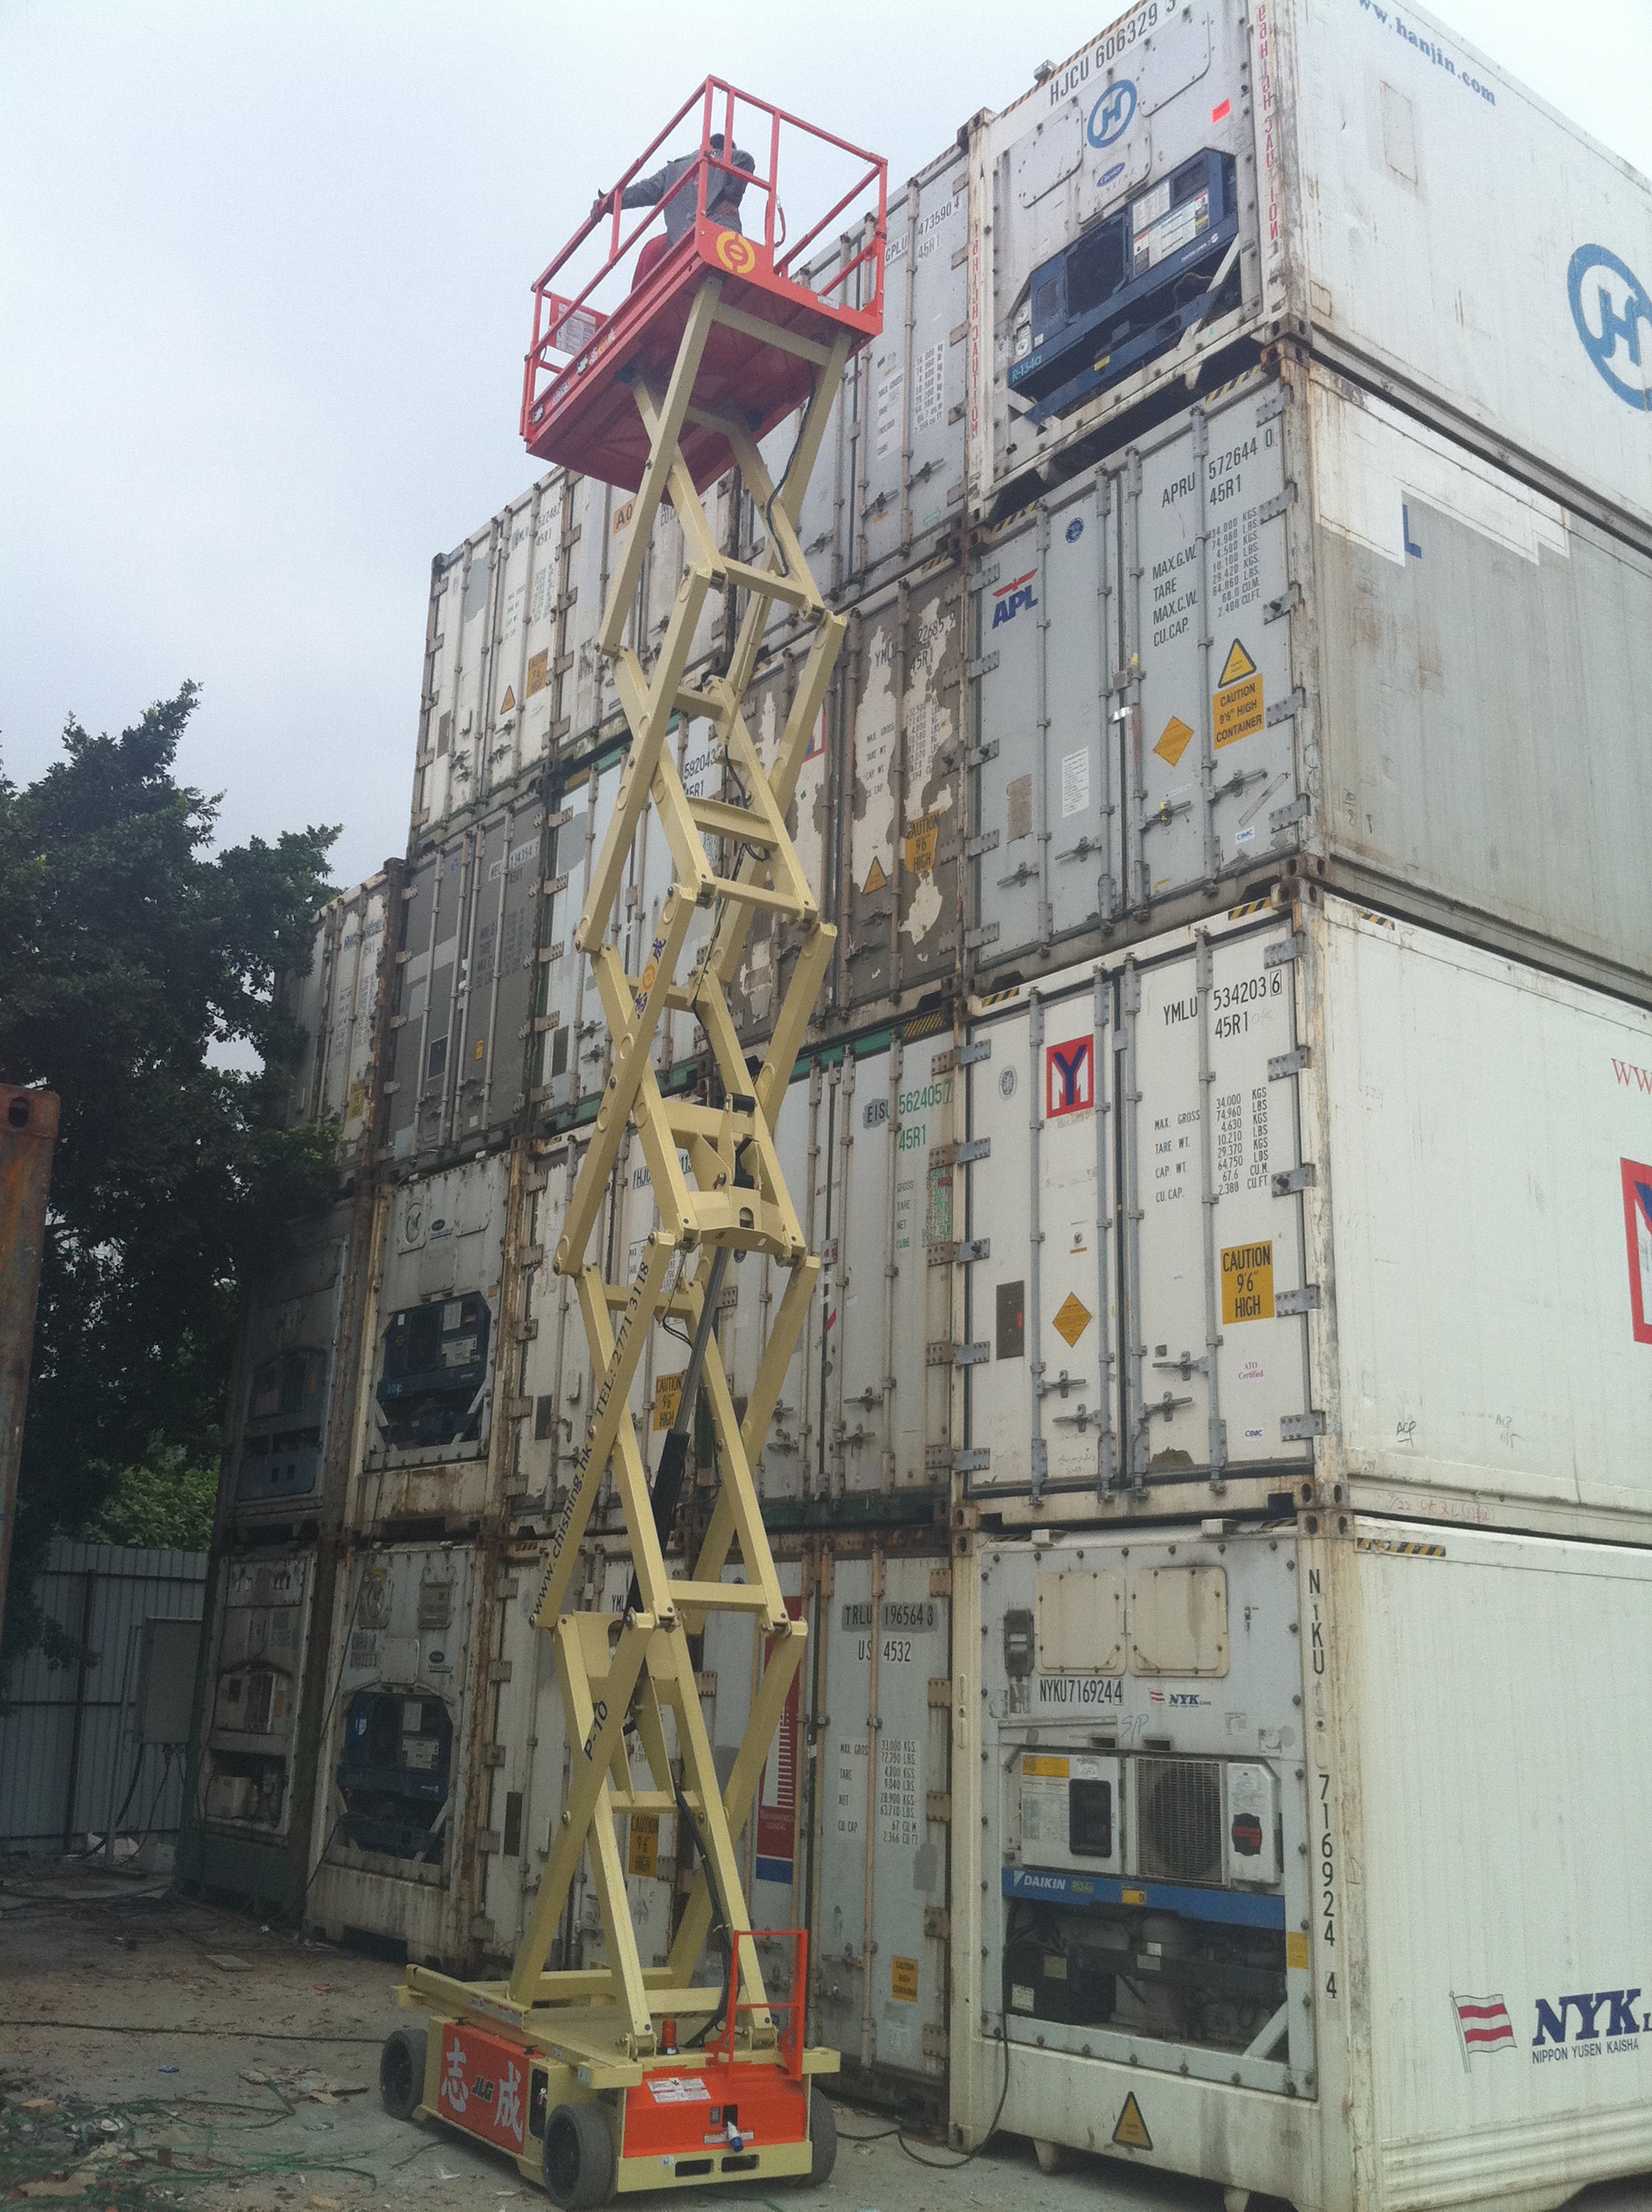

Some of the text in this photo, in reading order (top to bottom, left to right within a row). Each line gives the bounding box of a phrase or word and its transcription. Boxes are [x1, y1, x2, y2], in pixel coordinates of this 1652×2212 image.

[1050, 2, 1158, 107] HJCU 606329
[918, 195, 960, 236] 473590 4
[885, 234, 909, 263] GPLU
[918, 235, 940, 259] 45R1
[1208, 437, 1258, 480] 572644
[1161, 471, 1195, 508] APRU
[1209, 474, 1242, 506] 45R1
[1153, 577, 1178, 602] TARE
[992, 585, 1038, 630] APL
[1220, 683, 1257, 708] CAUTION
[1236, 699, 1258, 719] HIGH
[1216, 713, 1263, 743] CONTAINER
[1213, 972, 1281, 1011] 534203 6
[1163, 996, 1198, 1026] YMLU
[1215, 1010, 1248, 1039] 45R1
[899, 1082, 942, 1115] 562405
[1252, 1086, 1267, 1101] KGS
[1252, 1099, 1268, 1113] LBS
[1178, 1109, 1201, 1125] GROSS
[1253, 1112, 1268, 1126] KGS
[899, 1123, 927, 1152] 45R1
[1253, 1124, 1268, 1138] LBS
[1253, 1137, 1268, 1150] KGS
[1155, 1140, 1172, 1155] TARE
[1254, 1150, 1269, 1163] LBS
[1222, 1244, 1271, 1272] CAUTION
[1234, 1294, 1261, 1318] HIGH
[596, 1261, 649, 1417] TEL: 2771 3118
[1238, 1370, 1265, 1381] Certified
[1244, 1361, 1259, 1371] ATO
[531, 1445, 593, 1616] www.chishing.hk
[845, 1604, 872, 1626] TRLU
[885, 1604, 924, 1626] 196564
[883, 1640, 911, 1662] 4532
[1168, 1693, 1199, 1705] NYK
[1024, 1874, 1066, 1890] DAIKIN
[1532, 1988, 1642, 2046] NYK
[1532, 2038, 1639, 2064] NIPPON YUSEN KAISHA
[440, 2036, 469, 2112] 志
[493, 2060, 524, 2144] 成
